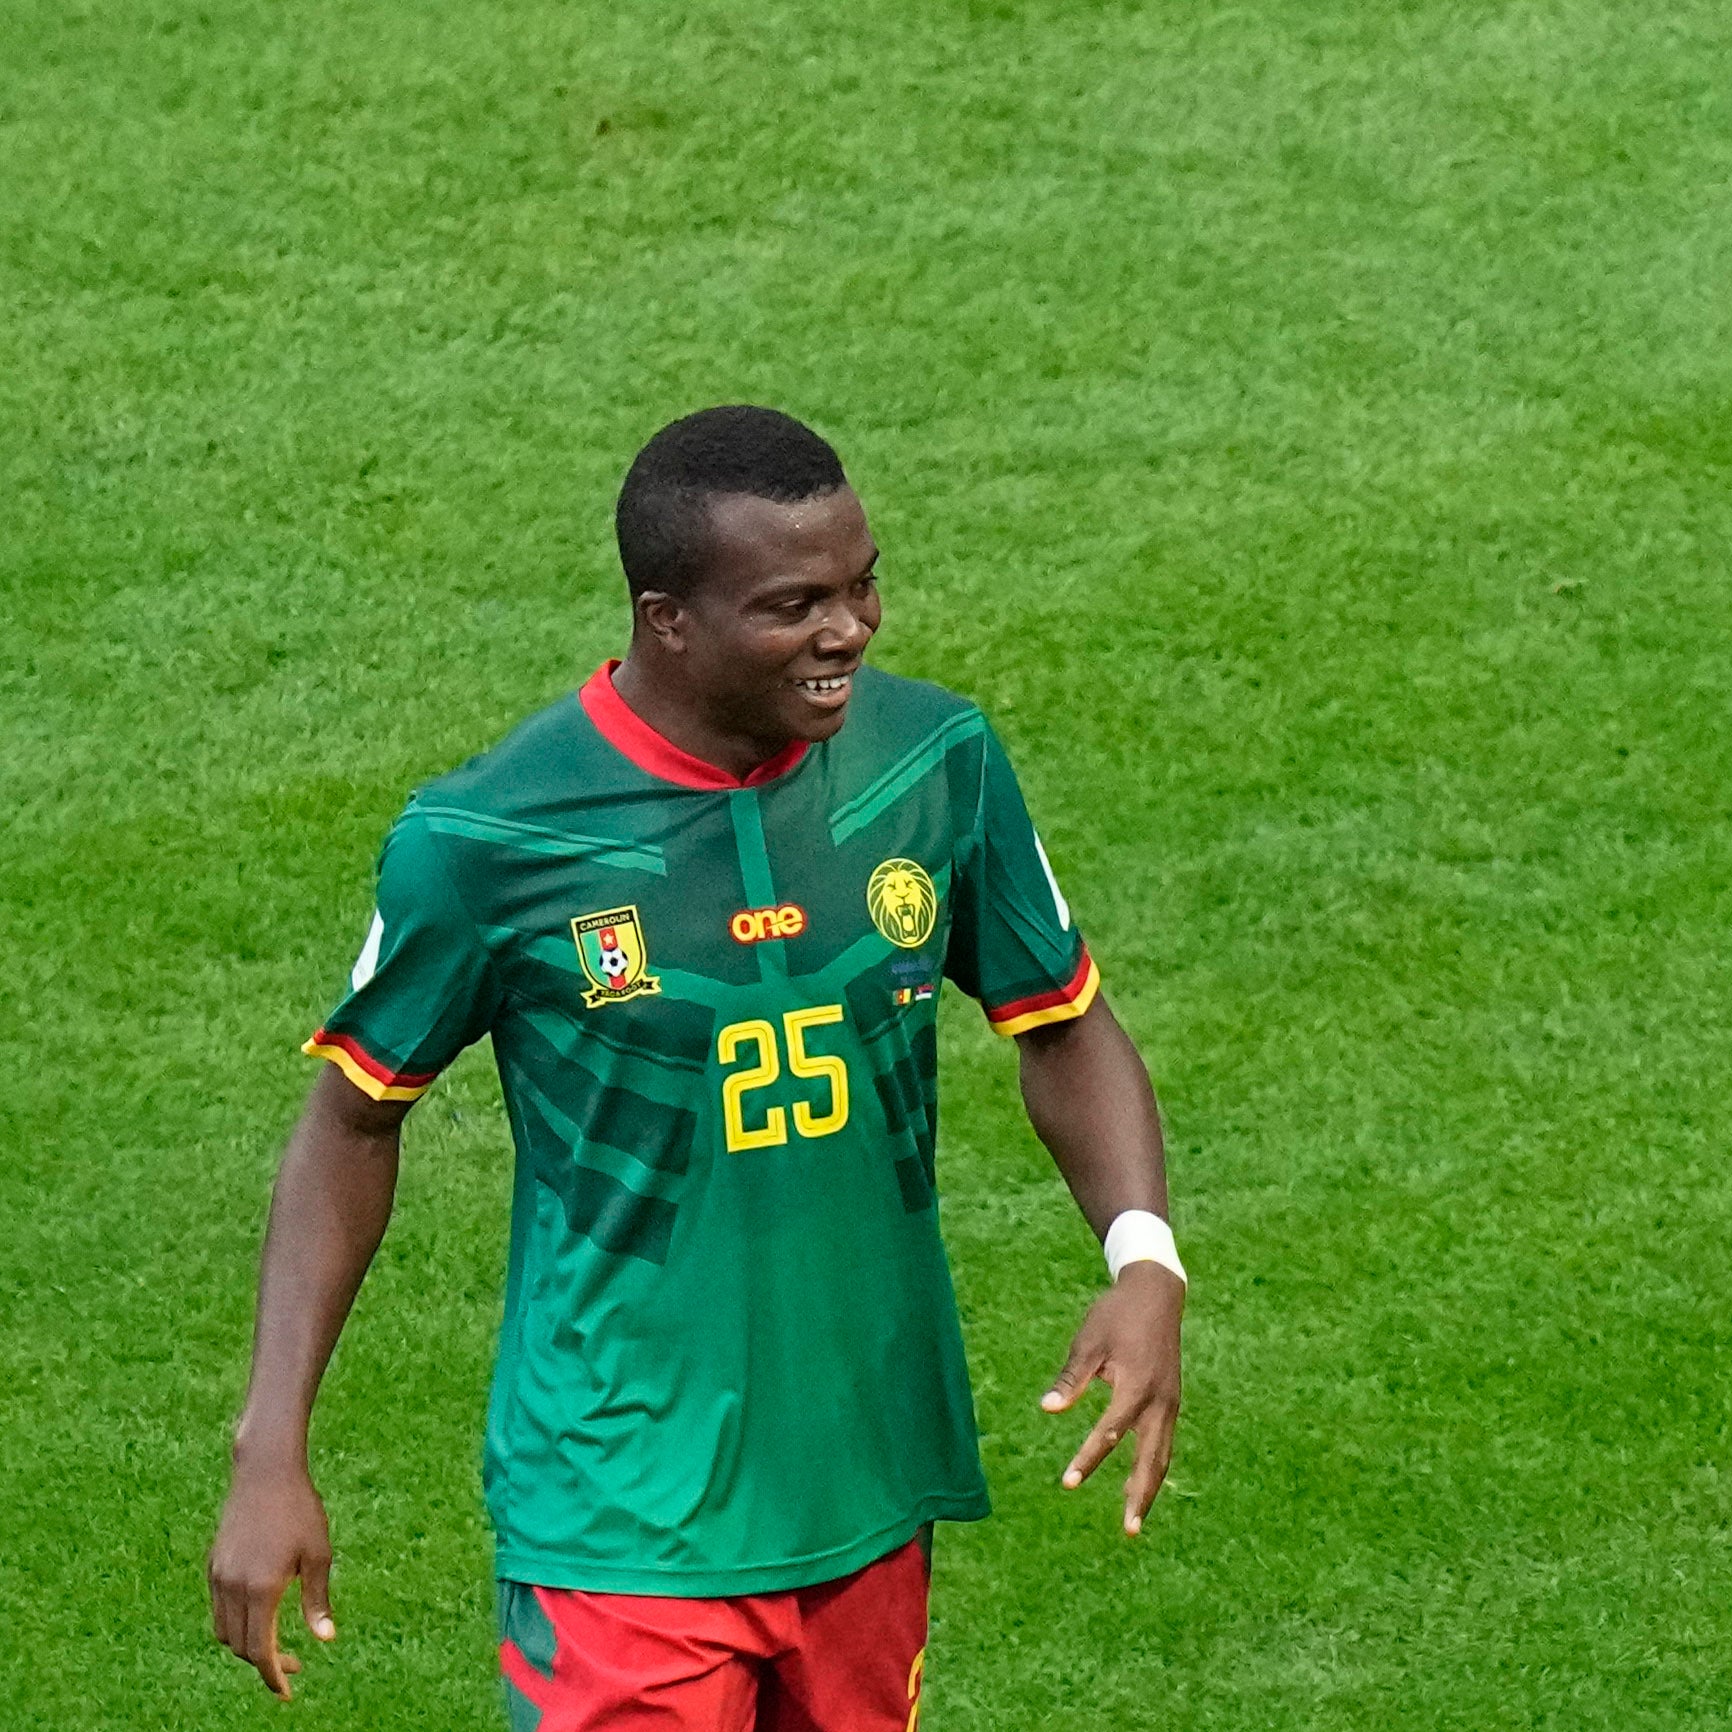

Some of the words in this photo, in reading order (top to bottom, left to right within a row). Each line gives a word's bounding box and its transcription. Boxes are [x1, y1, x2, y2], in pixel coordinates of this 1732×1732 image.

[580, 913, 630, 931] CAMEROUN
[731, 905, 804, 942] one
[717, 1003, 849, 1154] 25
